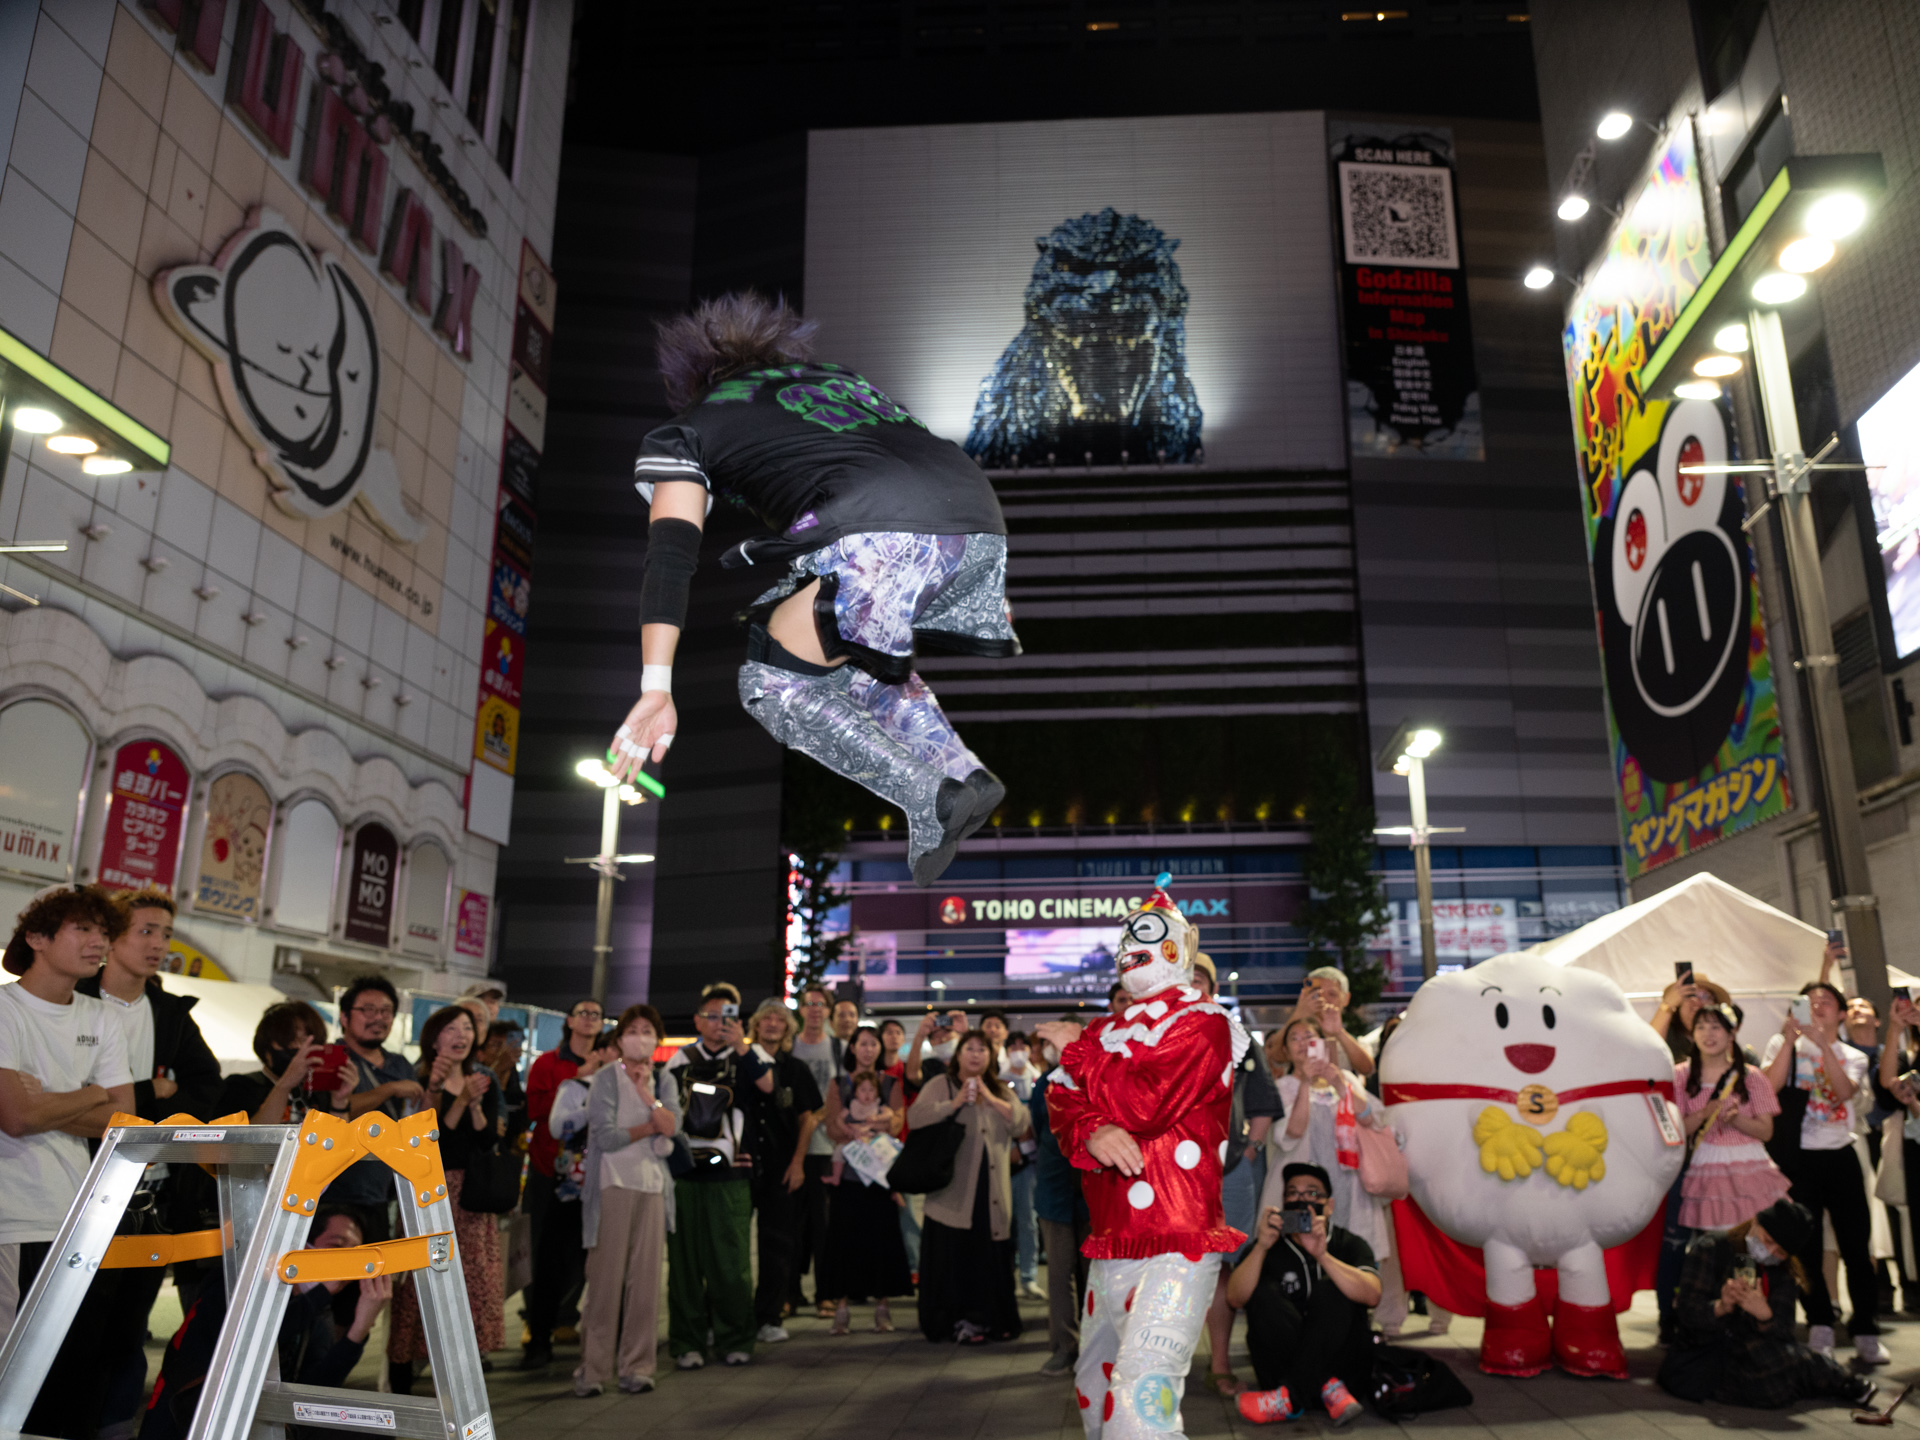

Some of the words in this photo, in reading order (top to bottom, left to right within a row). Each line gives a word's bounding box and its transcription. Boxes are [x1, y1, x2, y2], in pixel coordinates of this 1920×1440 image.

[1354, 147, 1393, 162] SCAN
[1395, 149, 1432, 165] HERE
[1355, 267, 1452, 292] Godzilla
[1357, 289, 1454, 308] Information
[1389, 308, 1425, 327] Map
[329, 531, 433, 616] www.humax.co.jp
[116, 769, 182, 801] 卓球バー
[124, 800, 168, 824] カラオケ
[1628, 757, 1777, 859] ヤングマガジン
[0, 827, 62, 864] UMAX
[125, 835, 160, 856] ダーツ
[361, 849, 389, 877] MO
[357, 881, 386, 908] MO
[971, 899, 1036, 921] TOHO
[1039, 896, 1142, 920] CINEMAS
[1528, 1093, 1544, 1115] S
